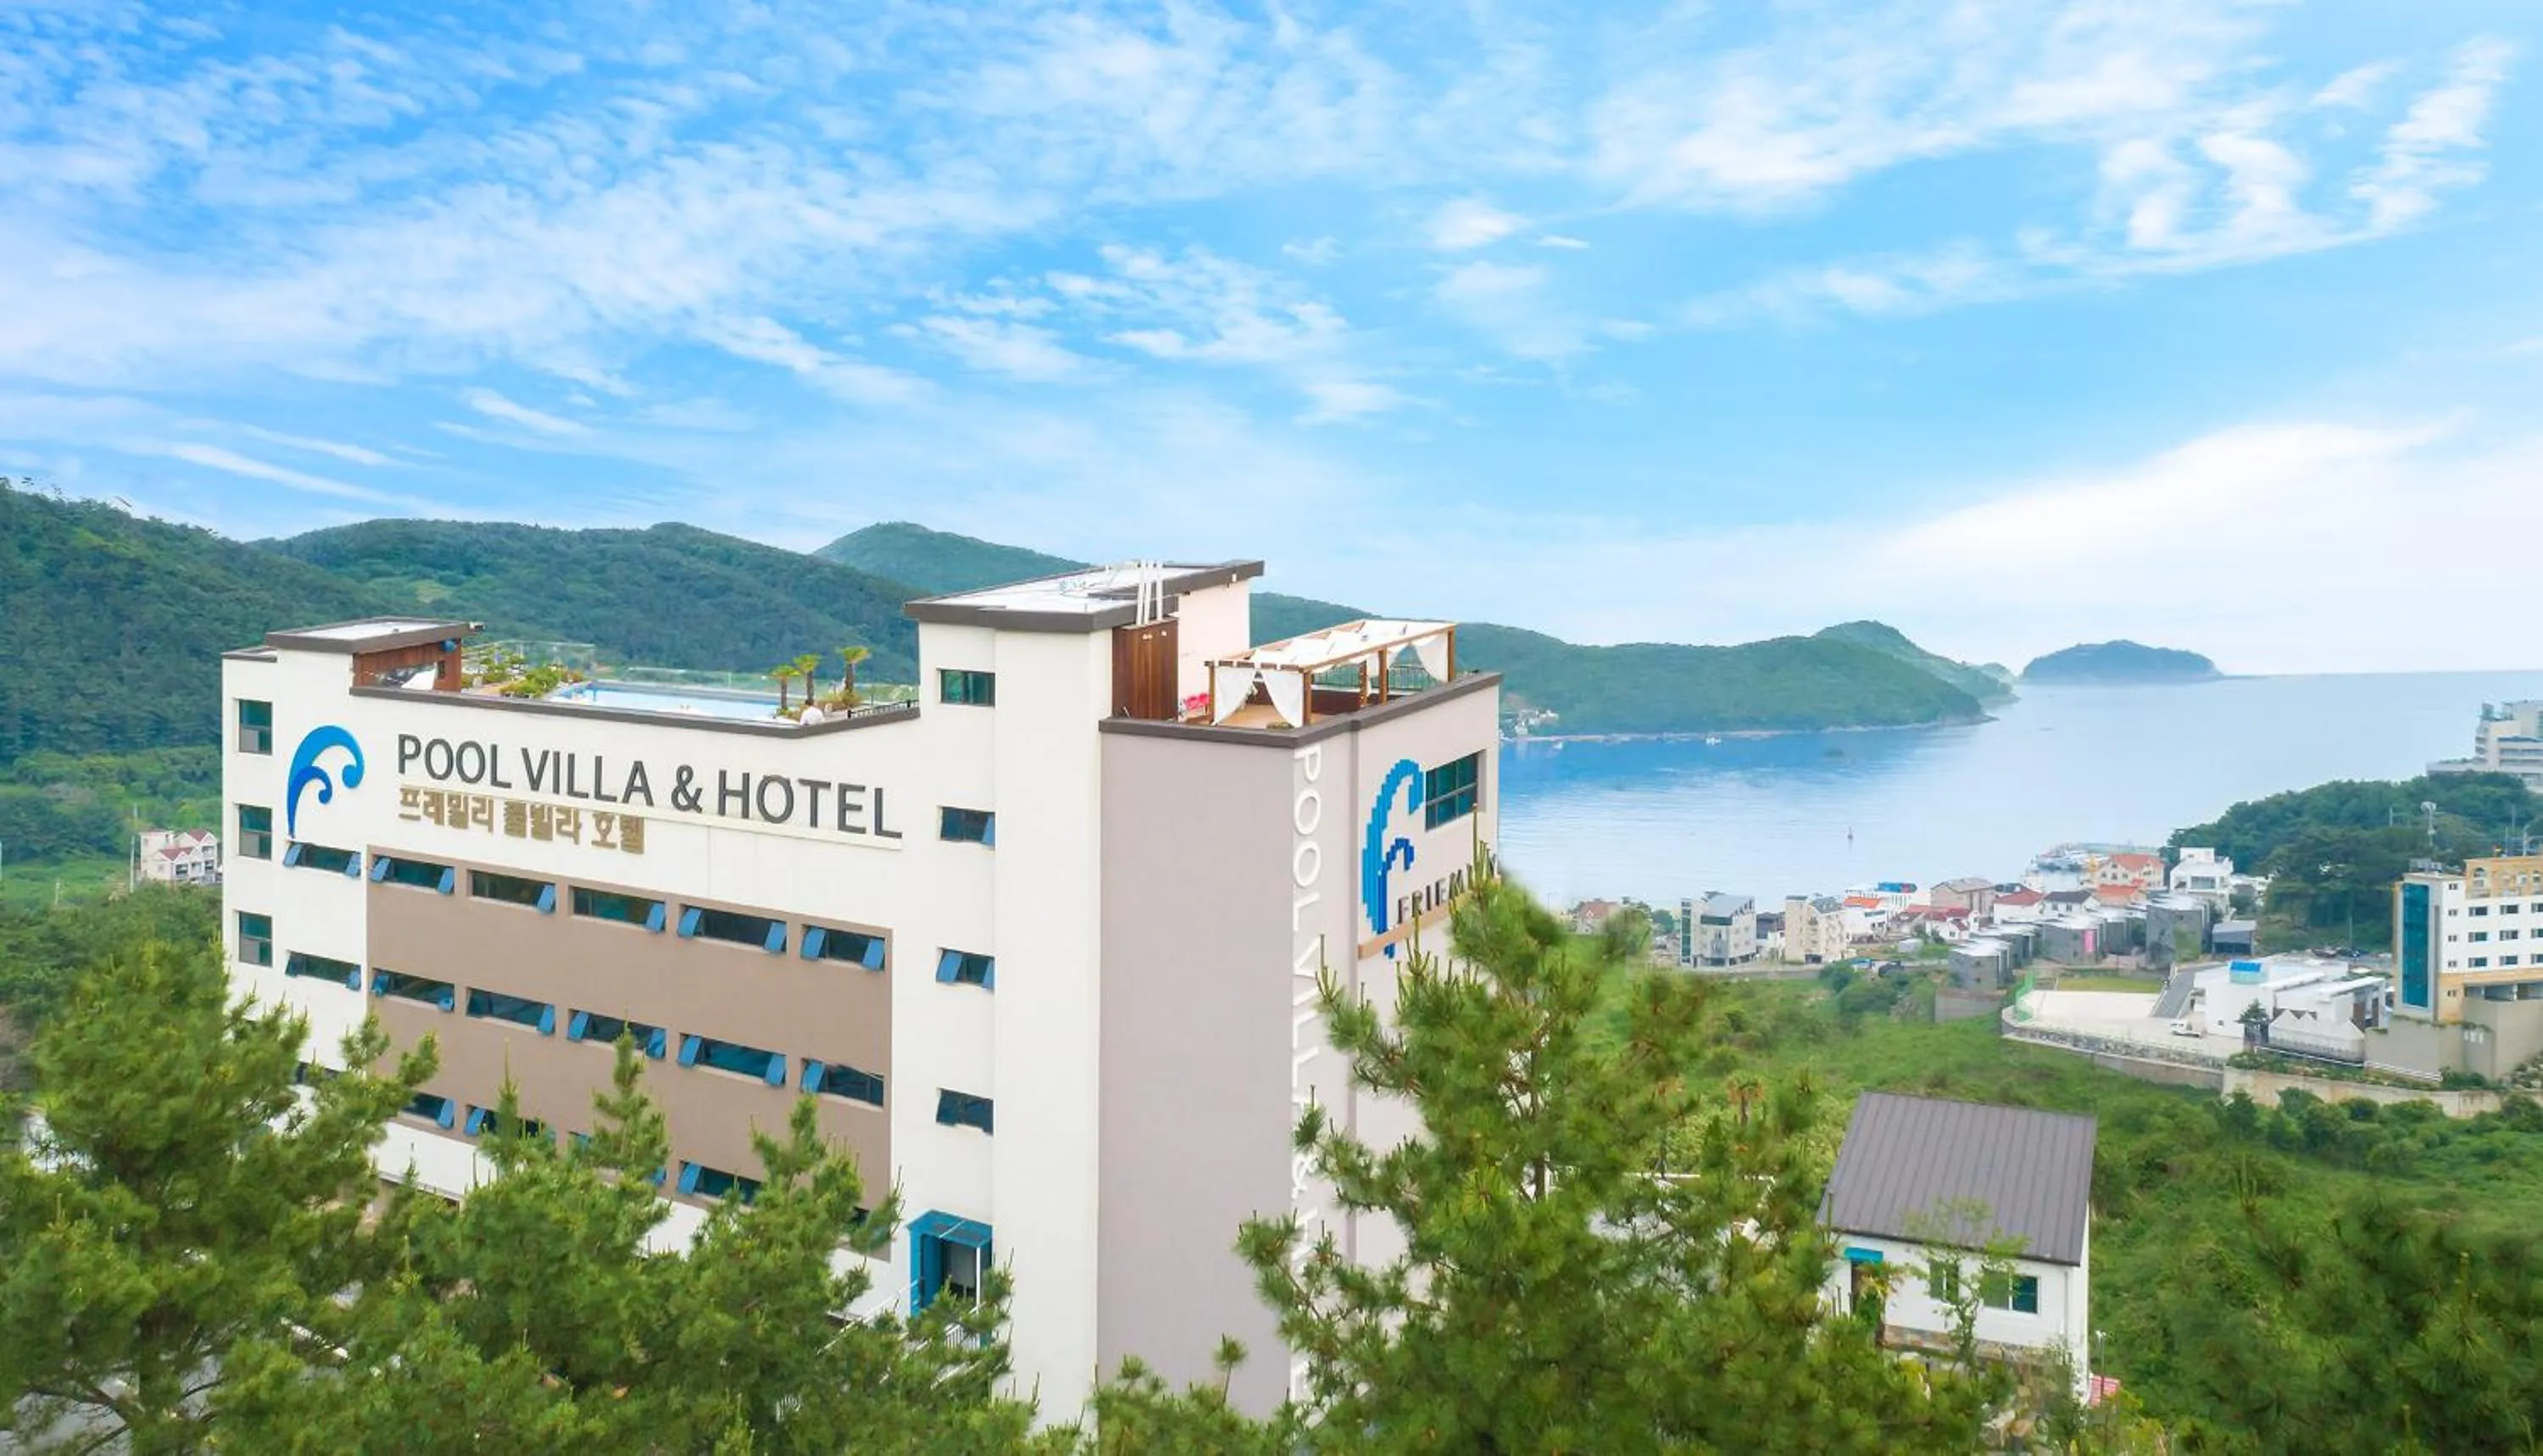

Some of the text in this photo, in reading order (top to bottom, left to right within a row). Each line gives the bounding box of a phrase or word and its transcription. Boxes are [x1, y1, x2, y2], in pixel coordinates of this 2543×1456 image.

[398, 734, 903, 840] POOL VILLA & HOTEL
[591, 810, 645, 855] 호텔
[1293, 744, 1322, 932] POOL
